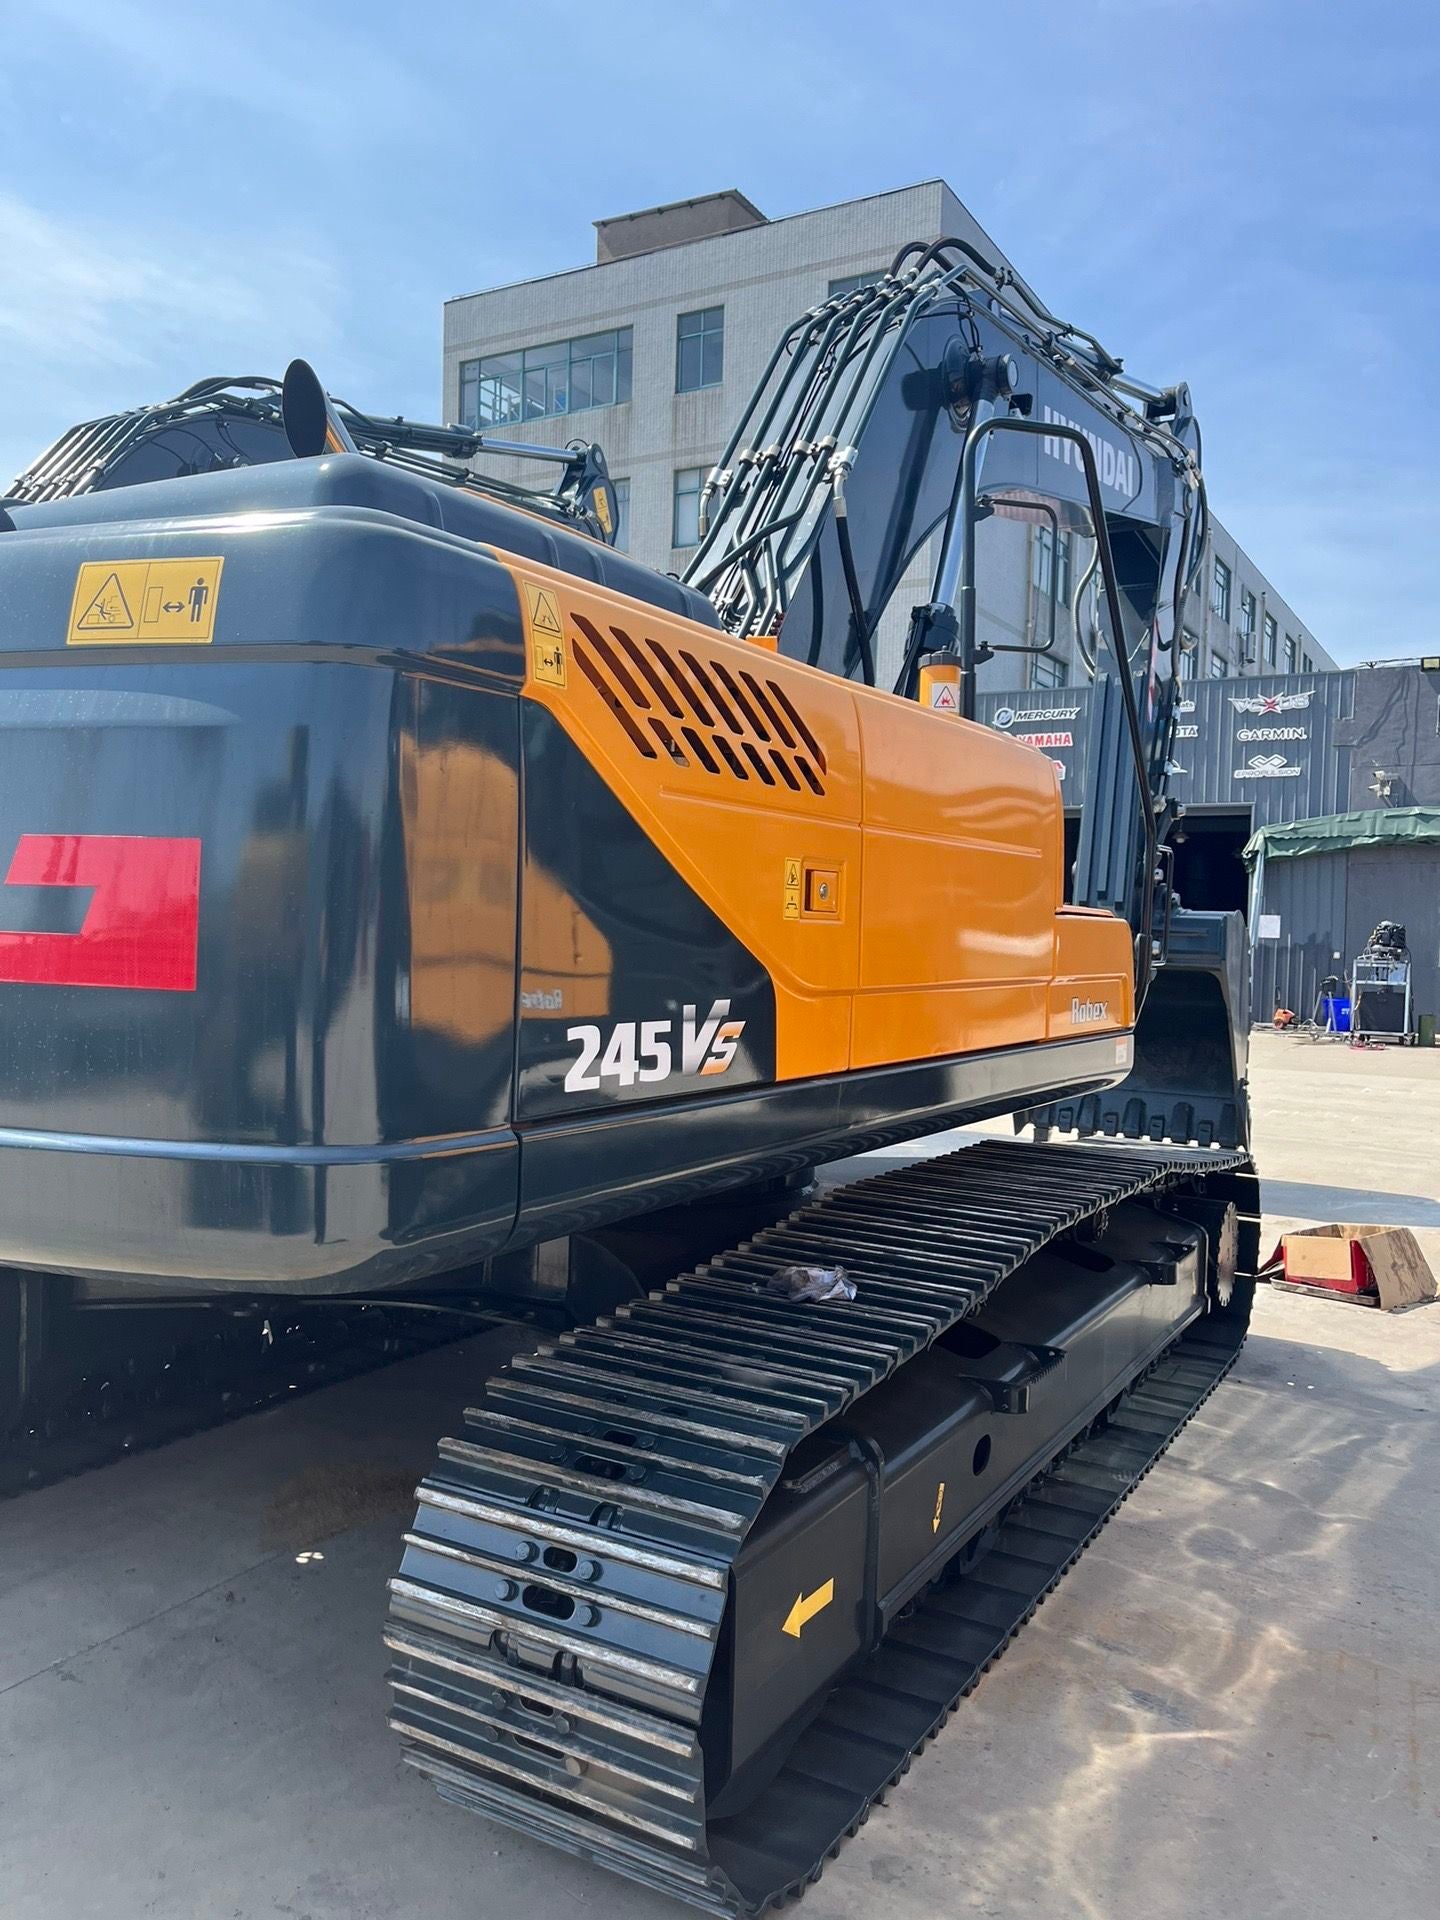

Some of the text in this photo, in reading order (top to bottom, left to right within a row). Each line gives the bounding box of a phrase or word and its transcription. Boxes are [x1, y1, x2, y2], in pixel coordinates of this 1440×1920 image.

[1016, 708, 1078, 721] MERCURY
[1071, 996, 1108, 1024] Robex
[564, 1020, 672, 1093] 245
